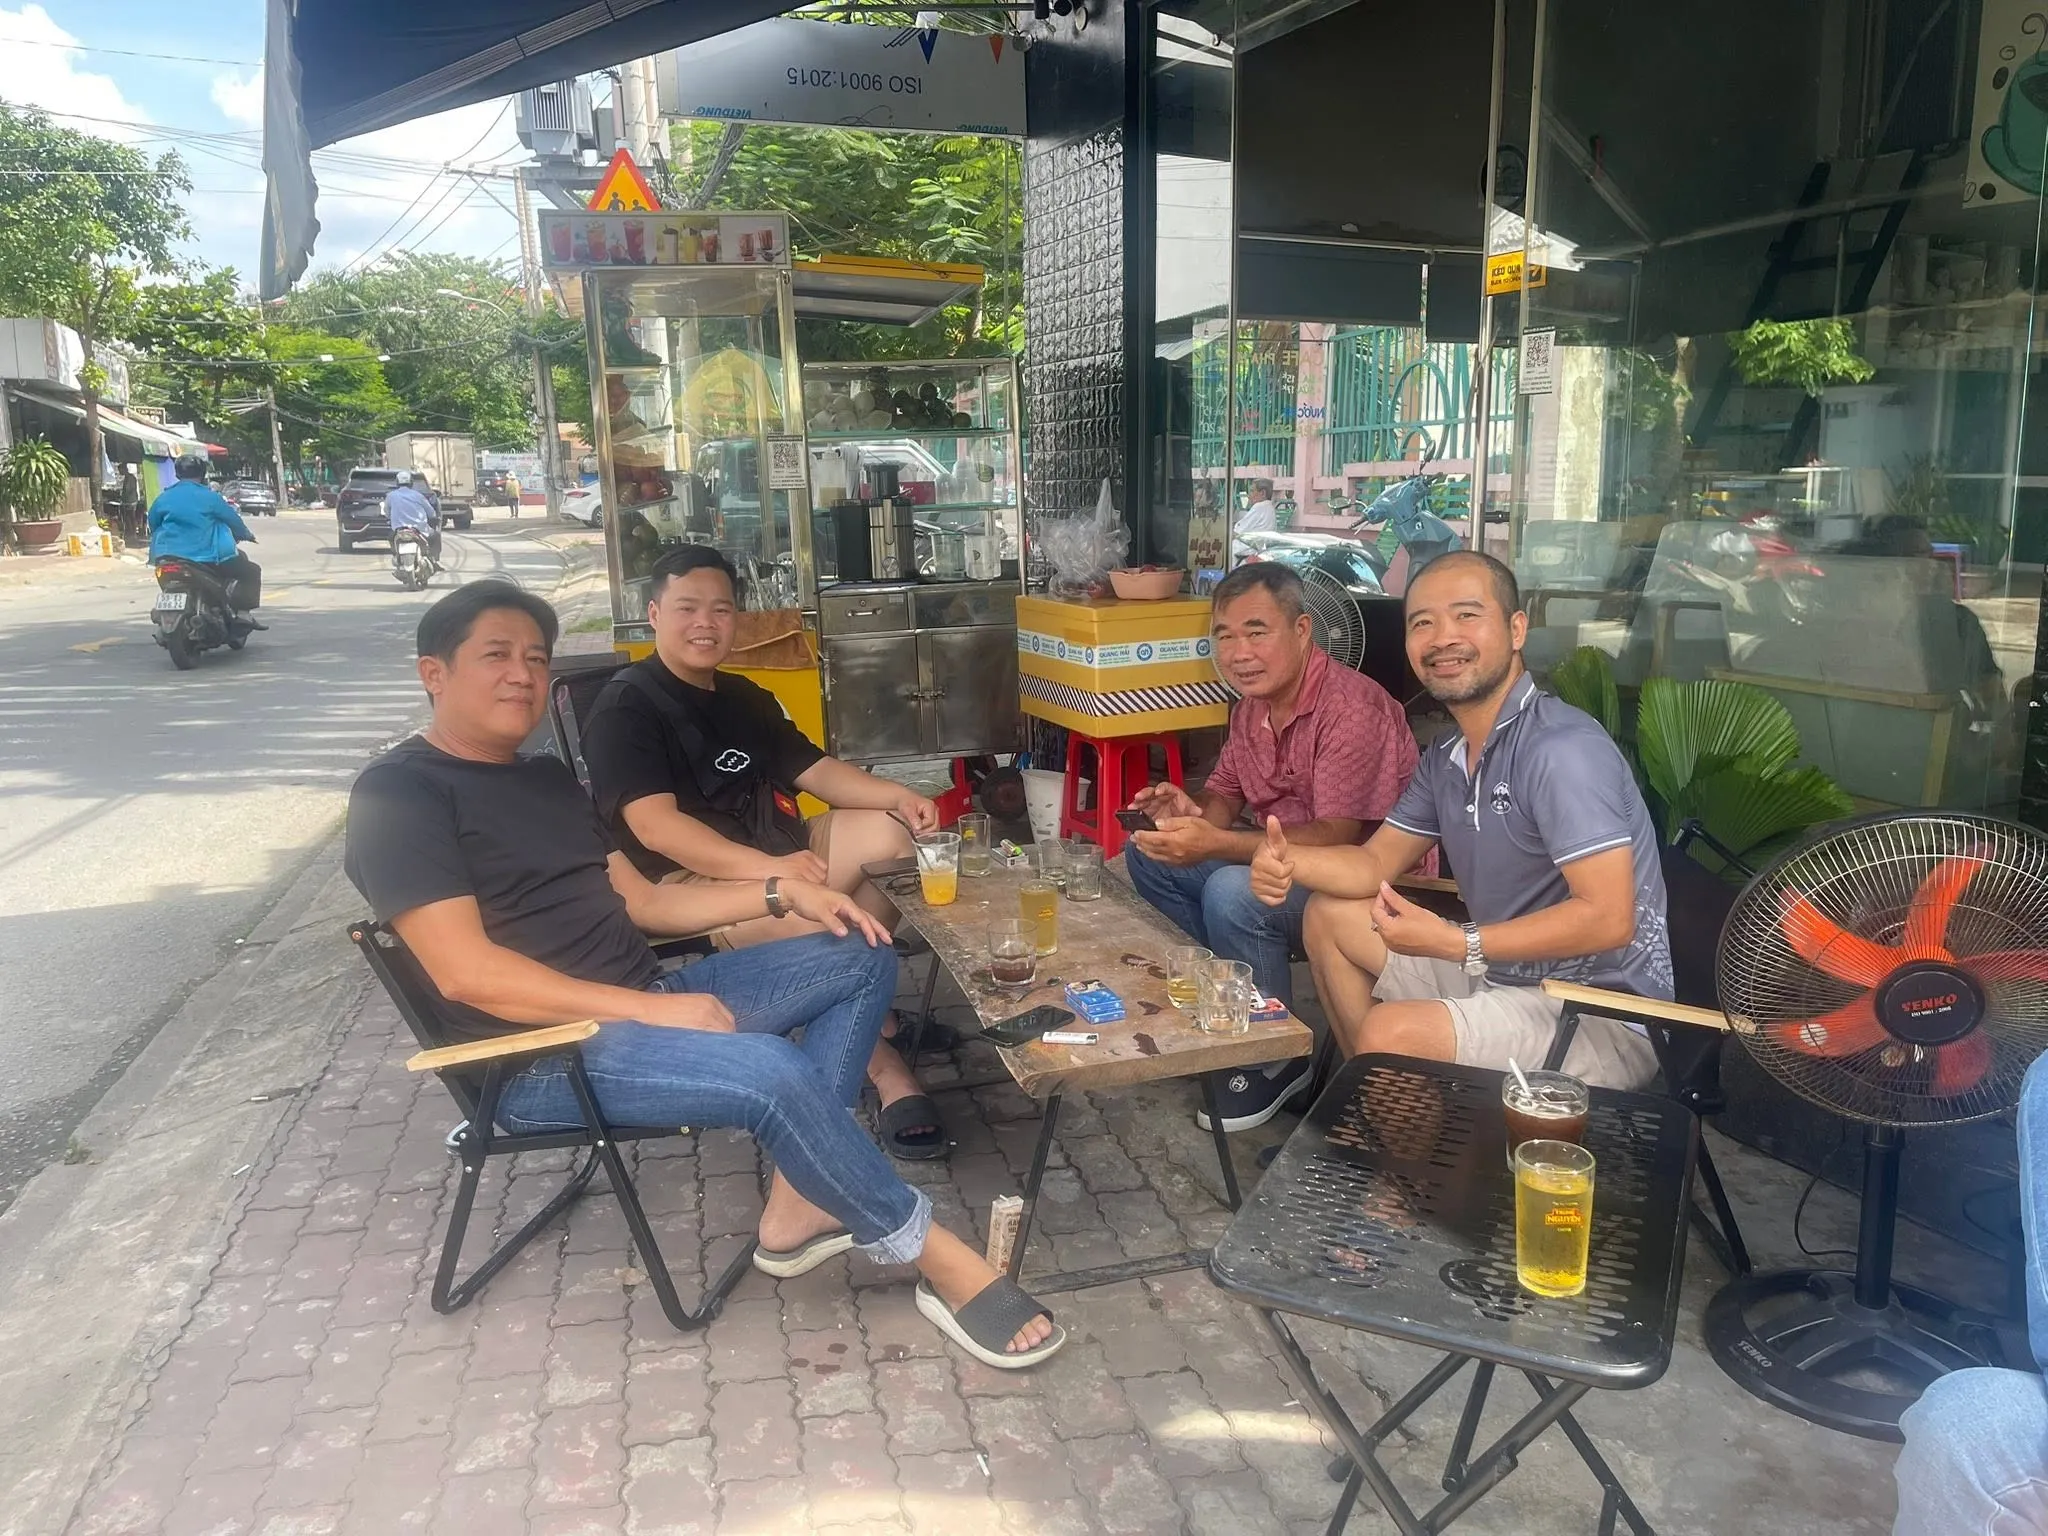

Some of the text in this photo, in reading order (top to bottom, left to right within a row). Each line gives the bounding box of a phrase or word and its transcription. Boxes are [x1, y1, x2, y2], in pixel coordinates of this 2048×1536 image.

[786, 67, 923, 95] ISO 9001:2015
[1901, 993, 1959, 1012] SENKO
[1736, 1340, 1773, 1368] SENKO
